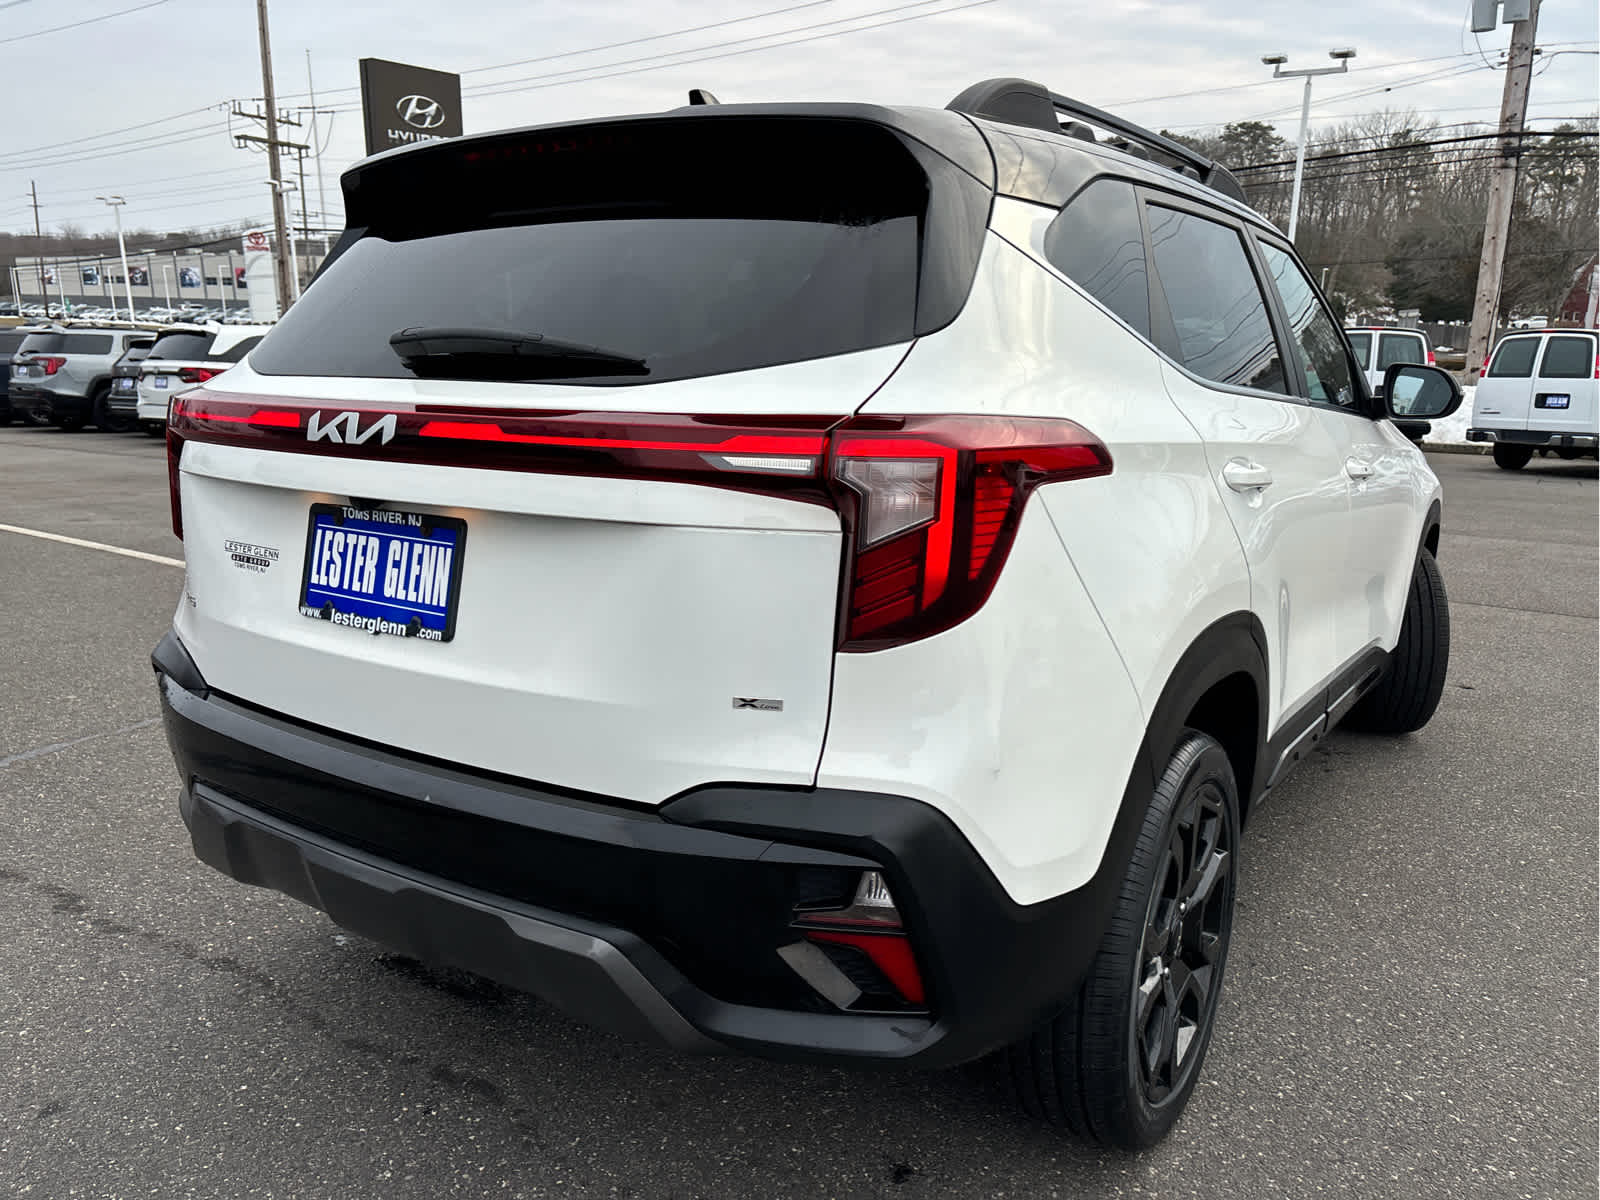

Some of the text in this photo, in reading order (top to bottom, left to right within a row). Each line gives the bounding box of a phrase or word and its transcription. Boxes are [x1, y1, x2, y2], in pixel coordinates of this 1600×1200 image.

[306, 410, 398, 447] KIA
[342, 507, 422, 527] TOMS RIVER, NJ
[224, 541, 280, 560] LESTER GLENN
[310, 529, 453, 608] LESTER GLENN
